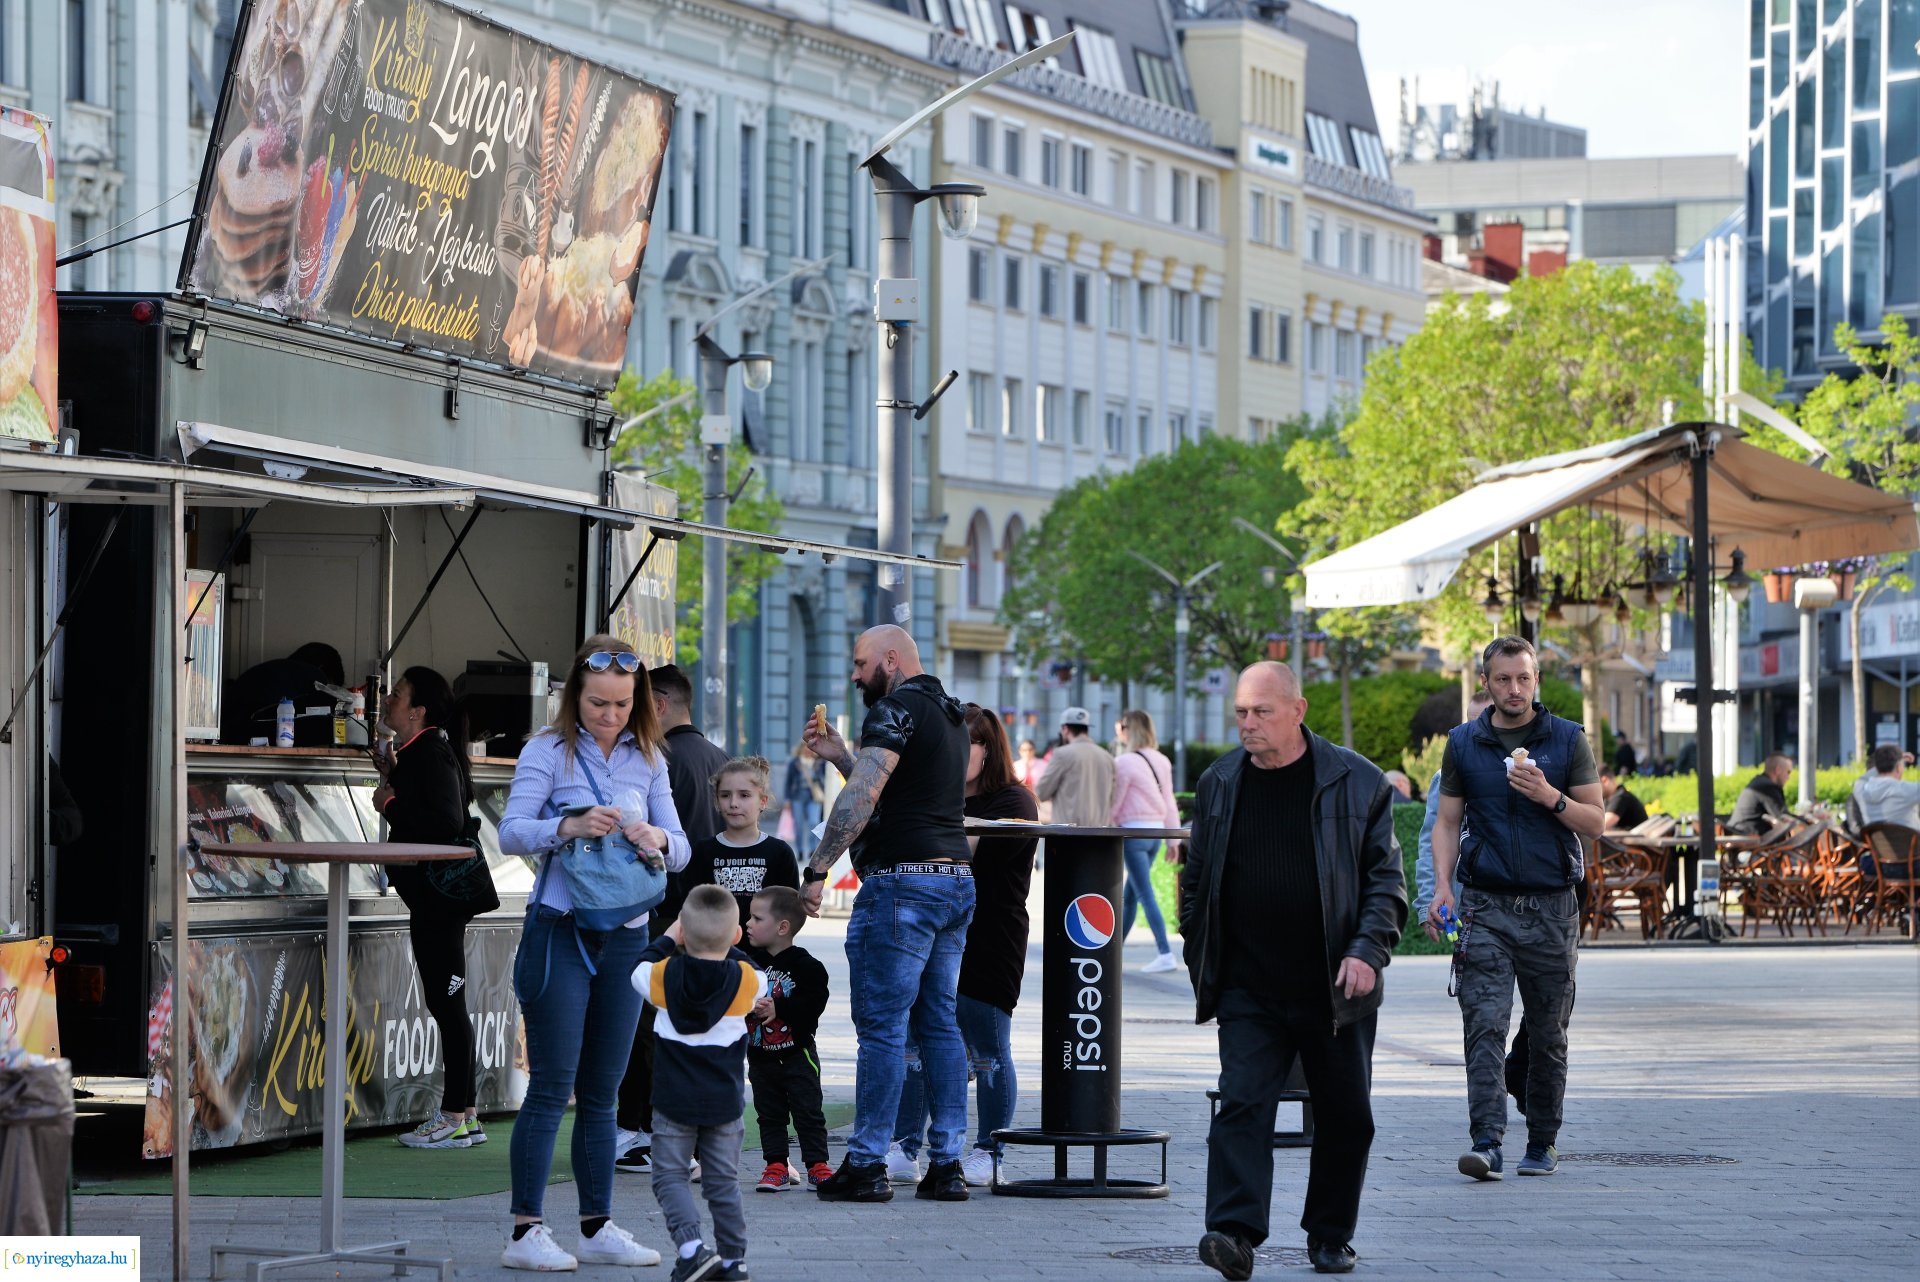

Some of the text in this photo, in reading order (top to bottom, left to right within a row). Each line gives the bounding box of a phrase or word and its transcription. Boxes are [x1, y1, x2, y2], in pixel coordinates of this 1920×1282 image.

[363, 87, 408, 122] FOOD TRUCK
[429, 17, 537, 179] Lángos
[351, 113, 470, 217] Spirál burgonya
[366, 185, 418, 255] Üdítők
[421, 207, 498, 288] Jégkása
[391, 283, 481, 341] palacsinta
[713, 857, 766, 867] Go your own
[898, 864, 935, 873] STREETS
[938, 865, 951, 874] HOT
[1068, 957, 1107, 1072] pepsi
[384, 1016, 438, 1080] FOOD
[1063, 1040, 1072, 1071] max
